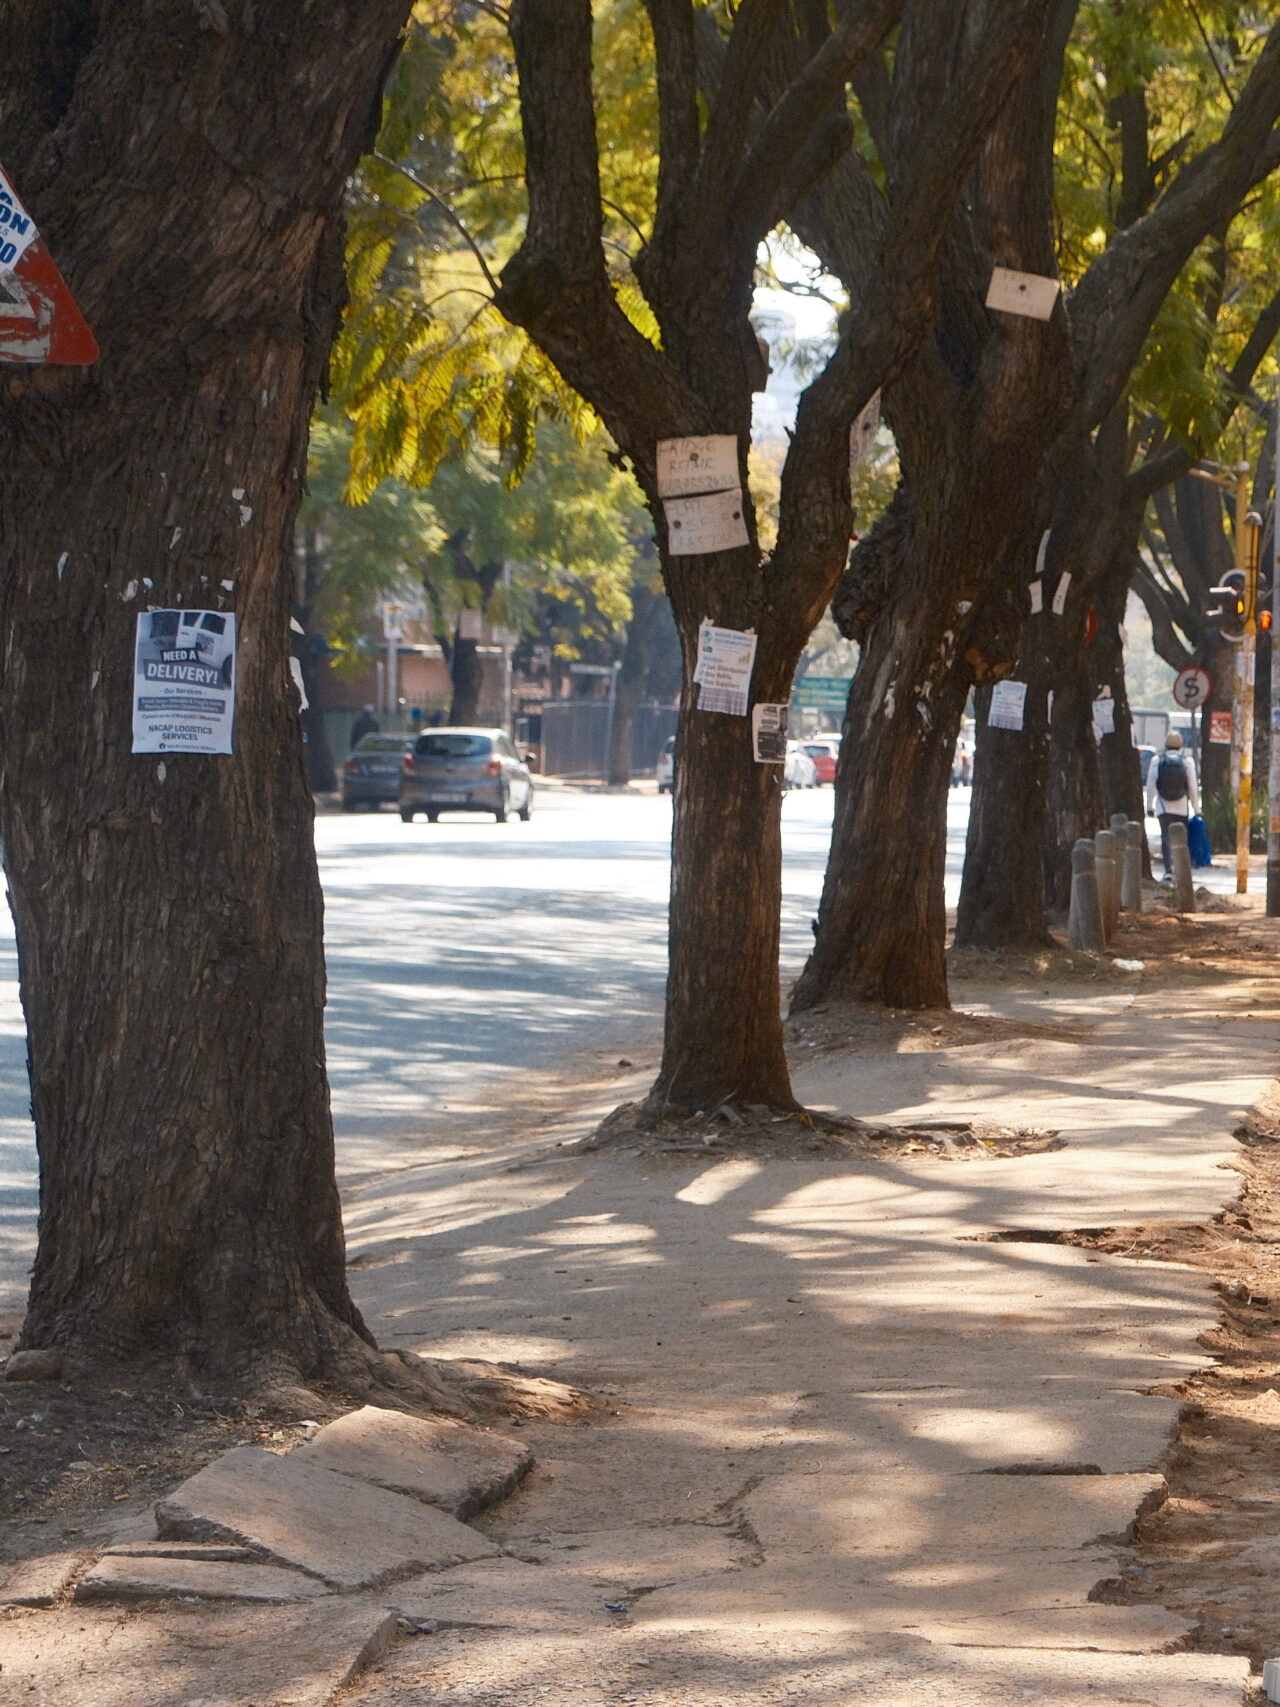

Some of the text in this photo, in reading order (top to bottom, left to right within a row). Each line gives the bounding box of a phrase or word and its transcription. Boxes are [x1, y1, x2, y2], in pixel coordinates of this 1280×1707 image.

[163, 650, 197, 662] NEED A
[147, 663, 219, 685] DELIVERY!
[175, 725, 213, 735] LOGISTICS
[162, 732, 198, 741] SERVICES
